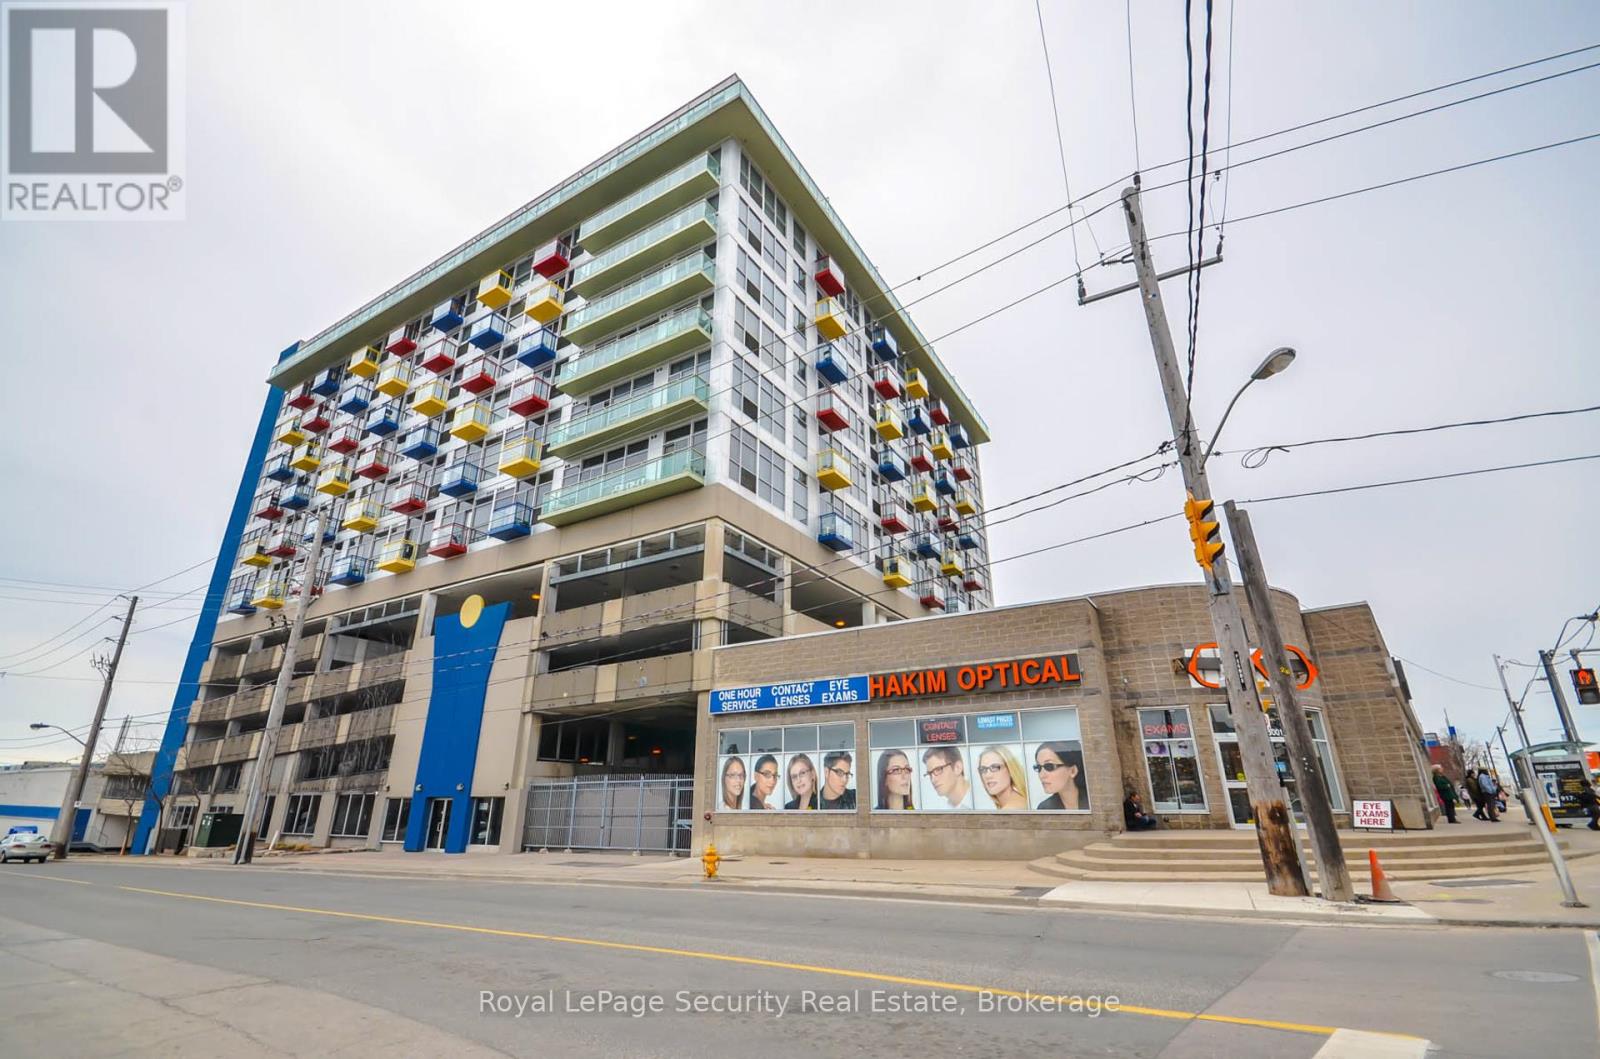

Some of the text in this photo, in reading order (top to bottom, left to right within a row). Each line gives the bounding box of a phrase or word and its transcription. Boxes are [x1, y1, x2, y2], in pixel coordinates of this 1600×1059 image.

[870, 656, 1080, 698] HAKIM OPTICAL
[771, 682, 816, 696] CONTACT
[829, 679, 850, 692] EYE
[718, 688, 761, 701] ONE HOUR
[774, 694, 811, 707] LENSES
[821, 690, 858, 703] EXAMS
[721, 699, 758, 712] SERVICE
[923, 720, 959, 731] CONTACT
[1144, 723, 1188, 736] EXAMS
[927, 732, 957, 742] LENSES
[1362, 802, 1381, 810] EYE
[1355, 810, 1390, 818] EXAMS
[1360, 818, 1386, 826] HERE
